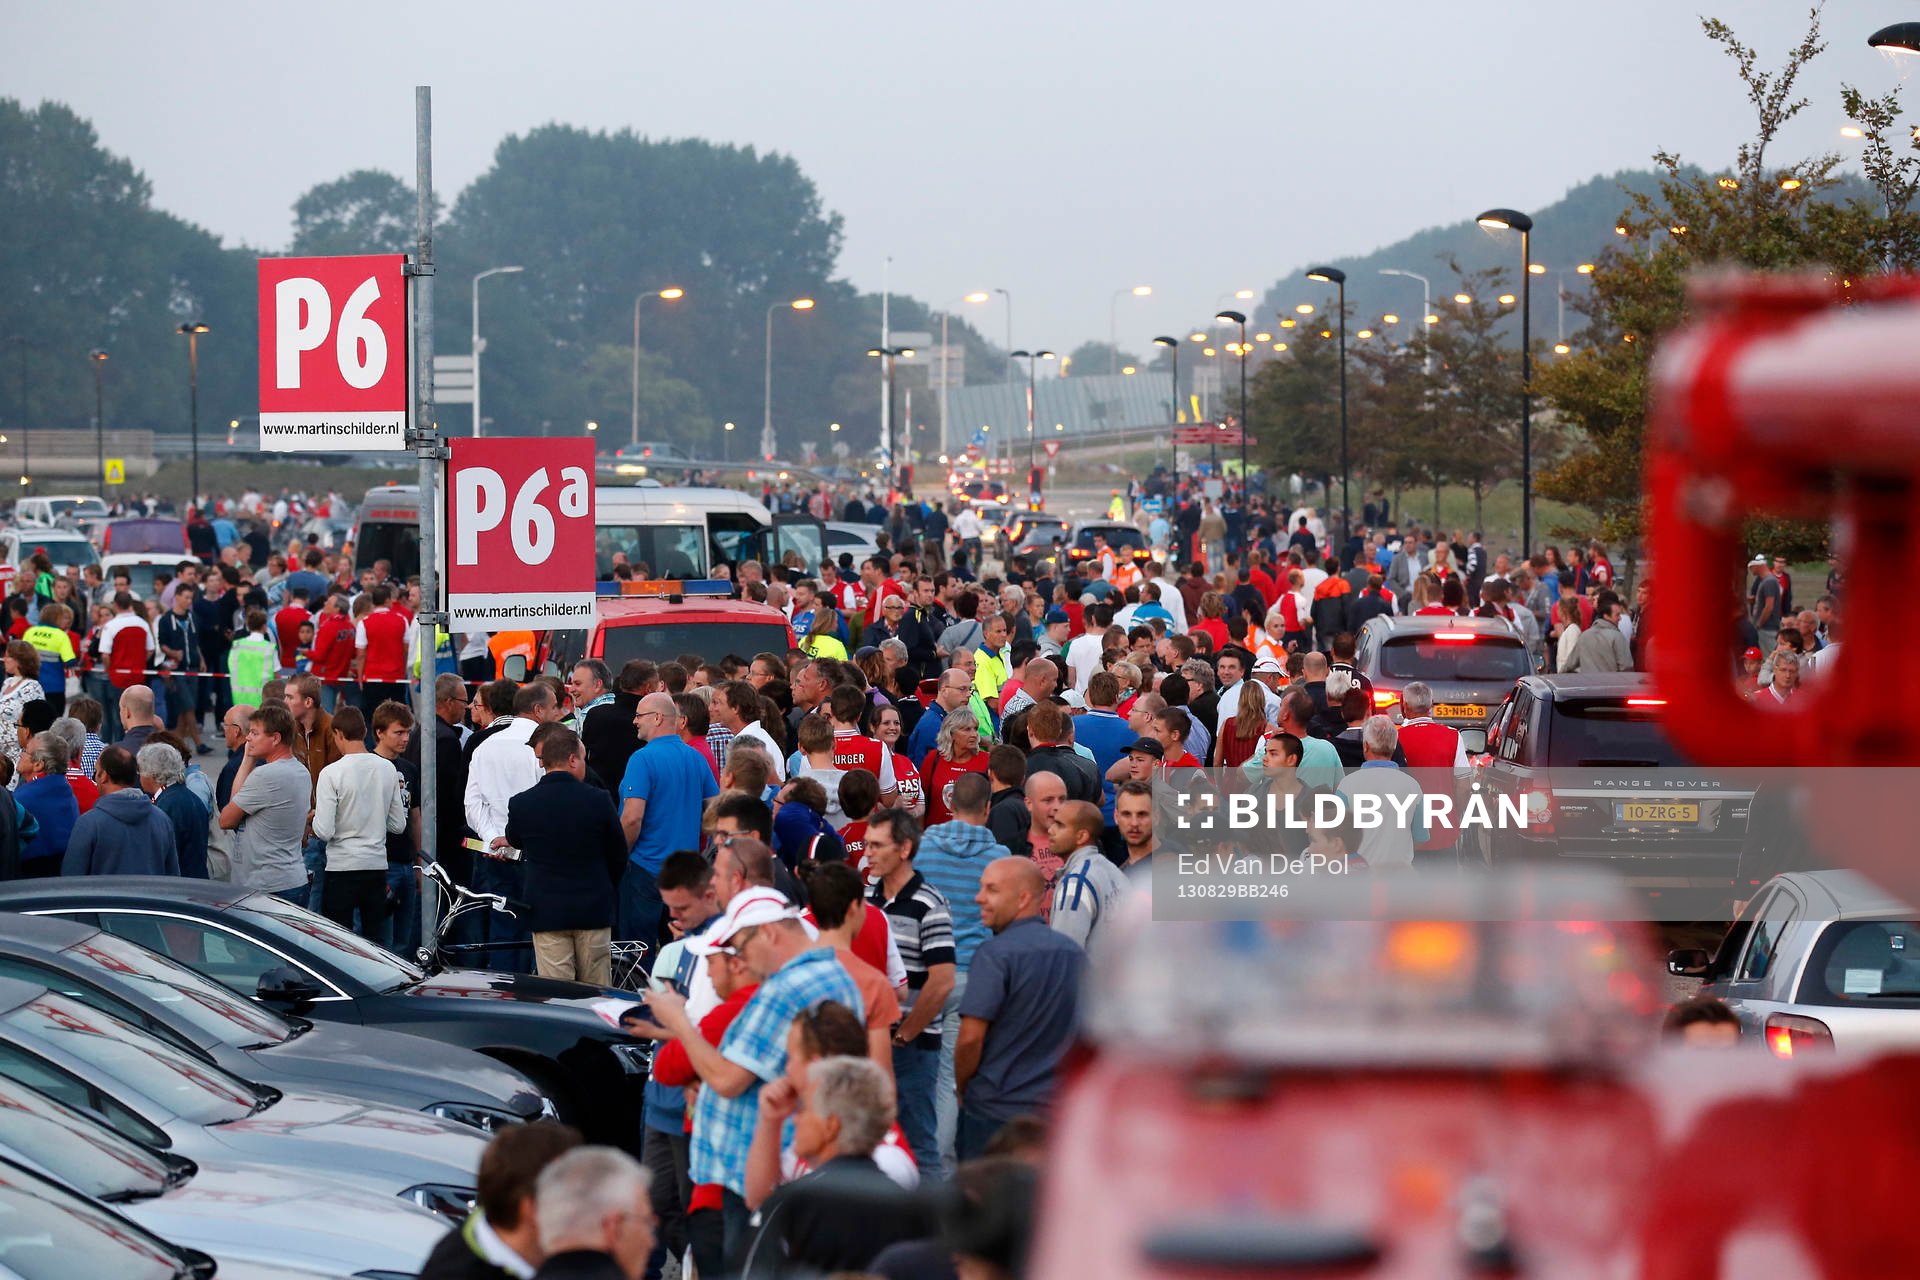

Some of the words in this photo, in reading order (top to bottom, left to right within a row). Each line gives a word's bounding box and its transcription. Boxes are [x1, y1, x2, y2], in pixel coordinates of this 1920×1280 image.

[276, 275, 388, 390] P6
[263, 421, 399, 435] www.martinschilder.nl
[456, 466, 589, 566] P6a
[454, 602, 591, 618] www.martinschilder.nl
[832, 753, 865, 766] URGER
[897, 778, 919, 793] FAS
[1629, 806, 1690, 819] 10-ZRG-5
